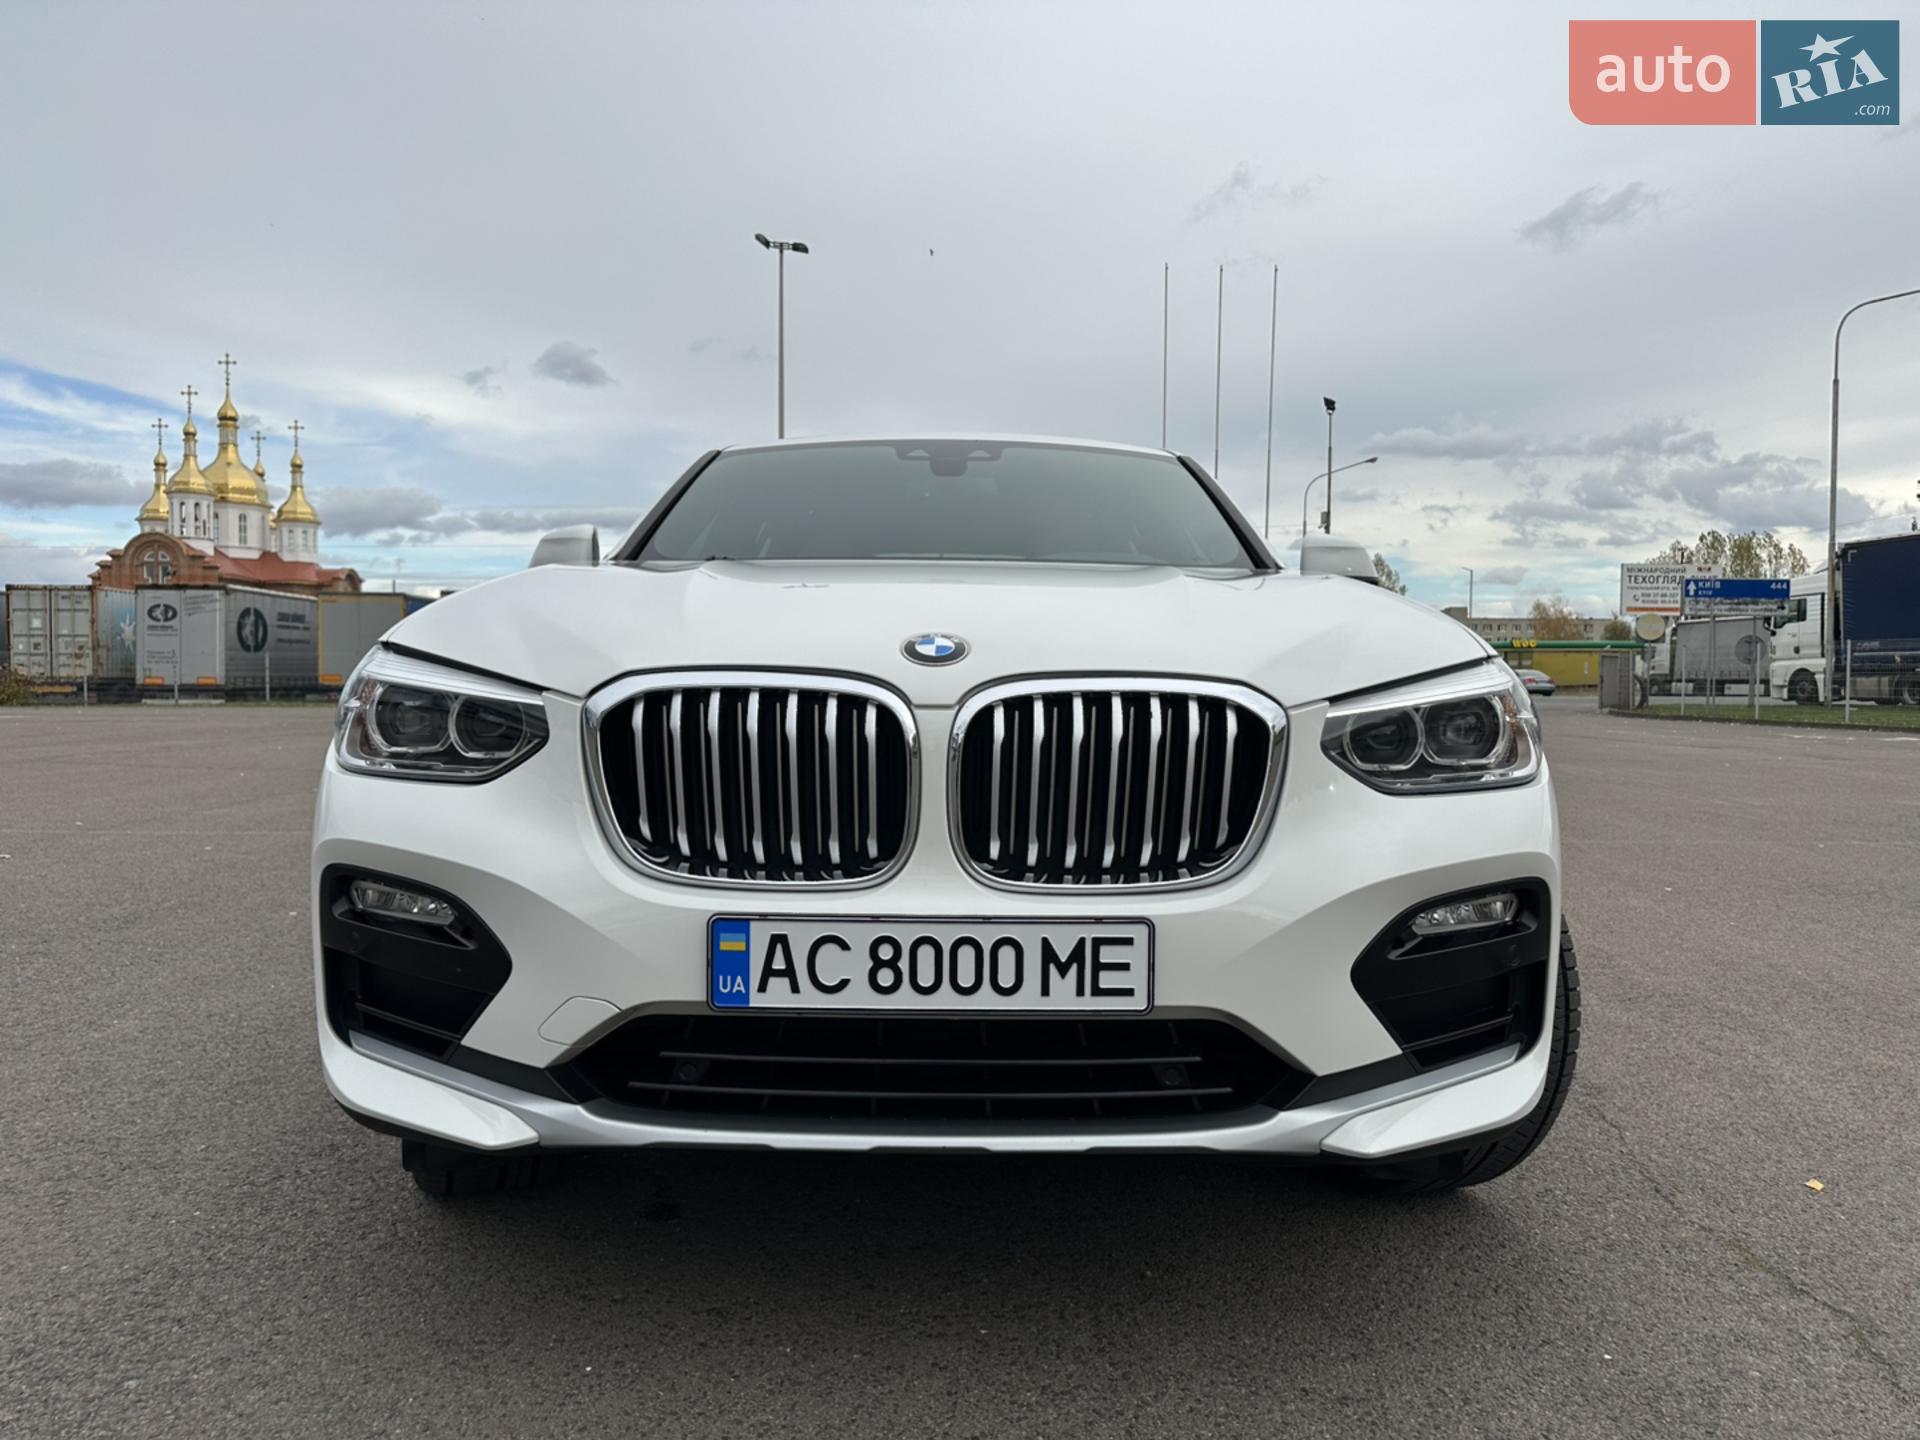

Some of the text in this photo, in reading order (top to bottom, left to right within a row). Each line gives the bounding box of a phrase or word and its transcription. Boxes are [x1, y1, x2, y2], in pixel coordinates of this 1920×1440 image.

[1626, 566, 1686, 575] МІЖНАРОДНИЙ
[1698, 580, 1788, 590] КИЇВ 444
[756, 933, 1135, 997] AC 8000 ME
[719, 975, 746, 994] UA
